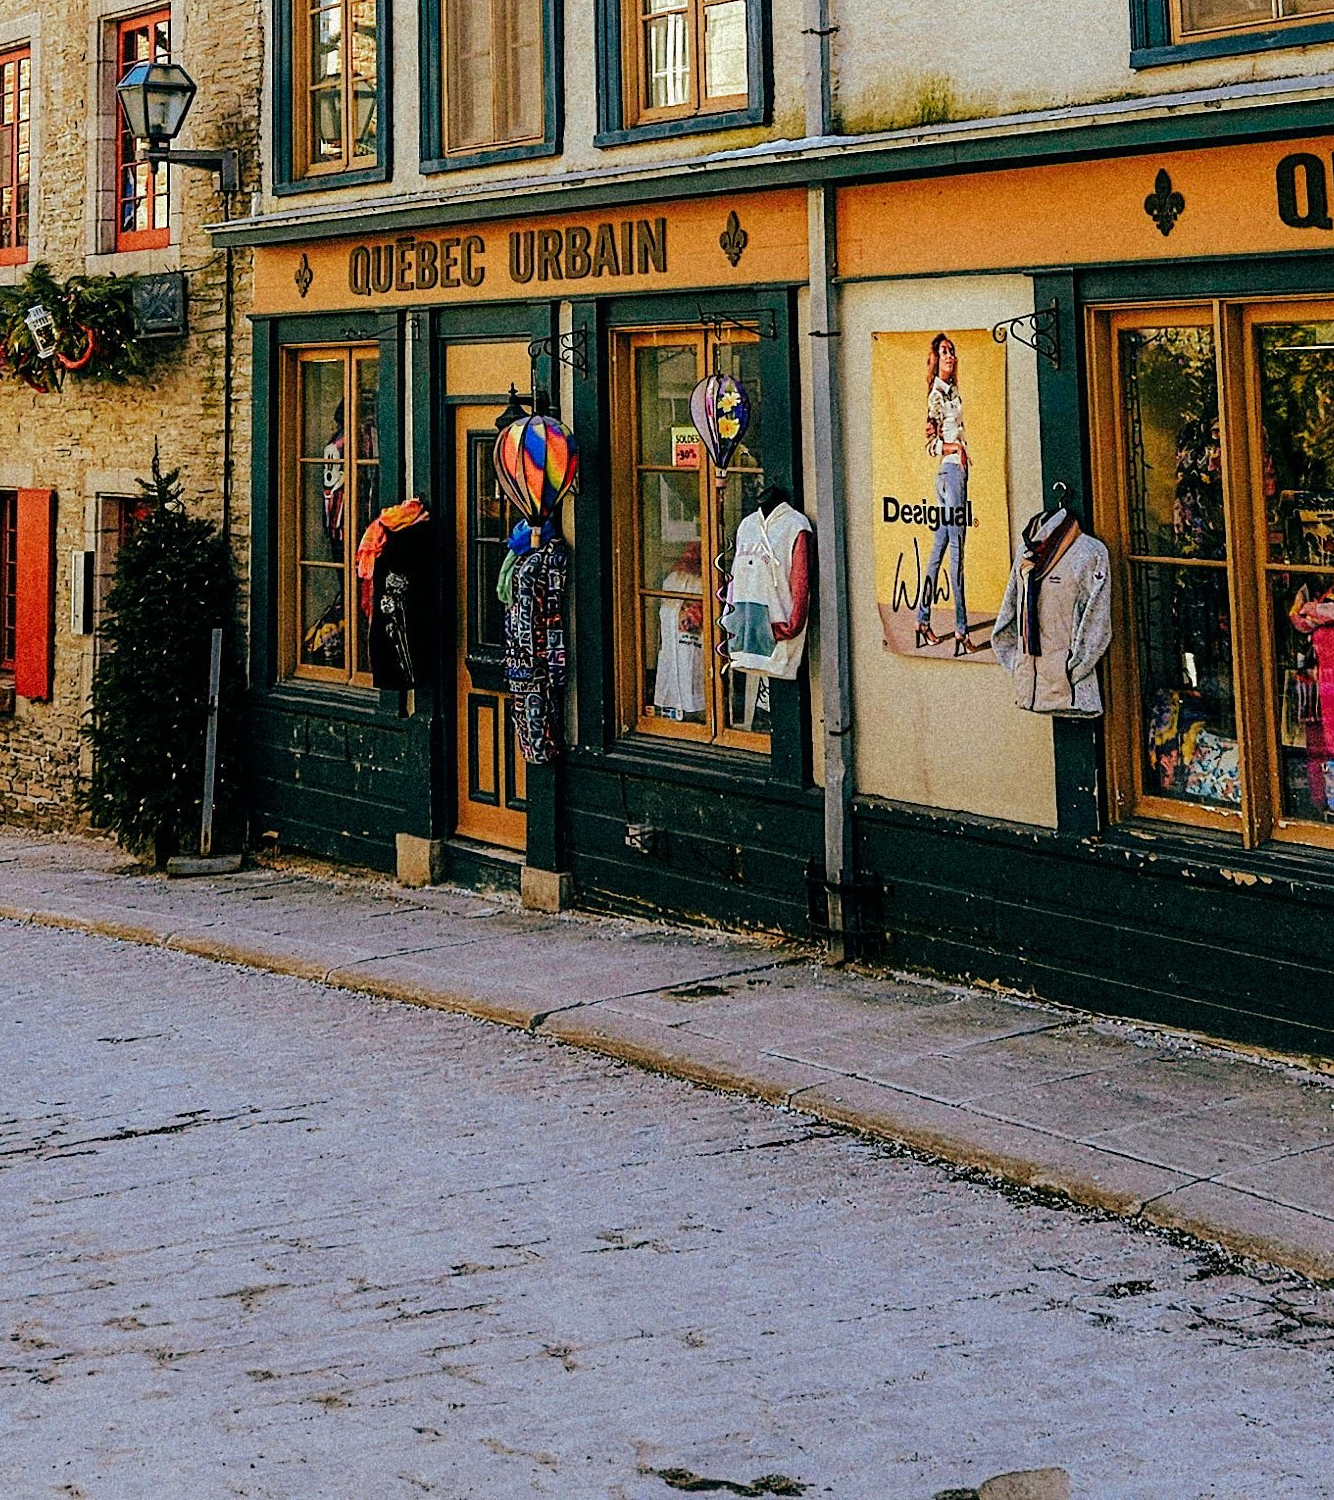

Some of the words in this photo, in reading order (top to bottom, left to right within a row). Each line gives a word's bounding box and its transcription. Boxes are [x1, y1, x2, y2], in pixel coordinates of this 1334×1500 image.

[509, 217, 668, 284] URBAIN
[675, 434, 699, 443] SOLDES
[883, 496, 973, 531] Desigual
